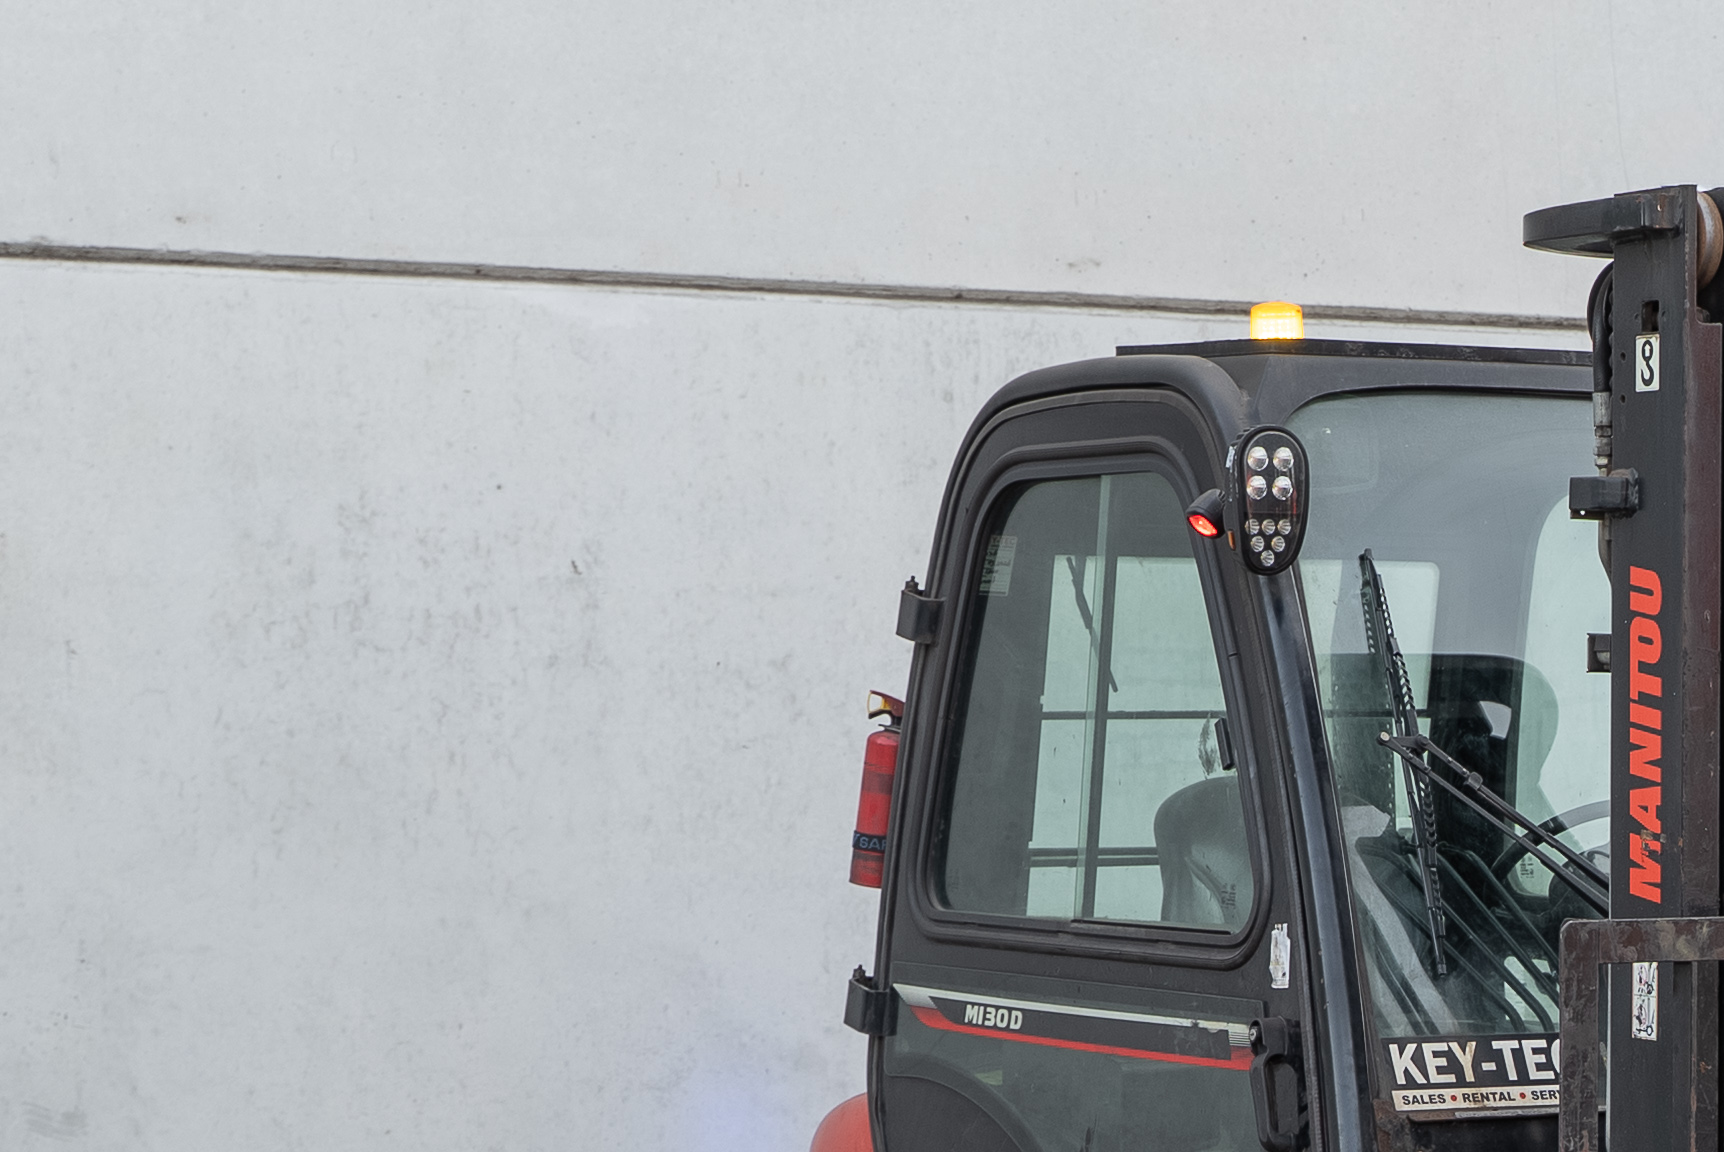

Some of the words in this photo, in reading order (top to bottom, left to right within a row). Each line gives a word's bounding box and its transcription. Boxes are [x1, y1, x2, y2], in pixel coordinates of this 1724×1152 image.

[1630, 566, 1662, 904] MANITOU
[964, 1004, 1023, 1030] MI30D
[1402, 1093, 1447, 1106] SALES
[1462, 1091, 1516, 1104] RENTAL
